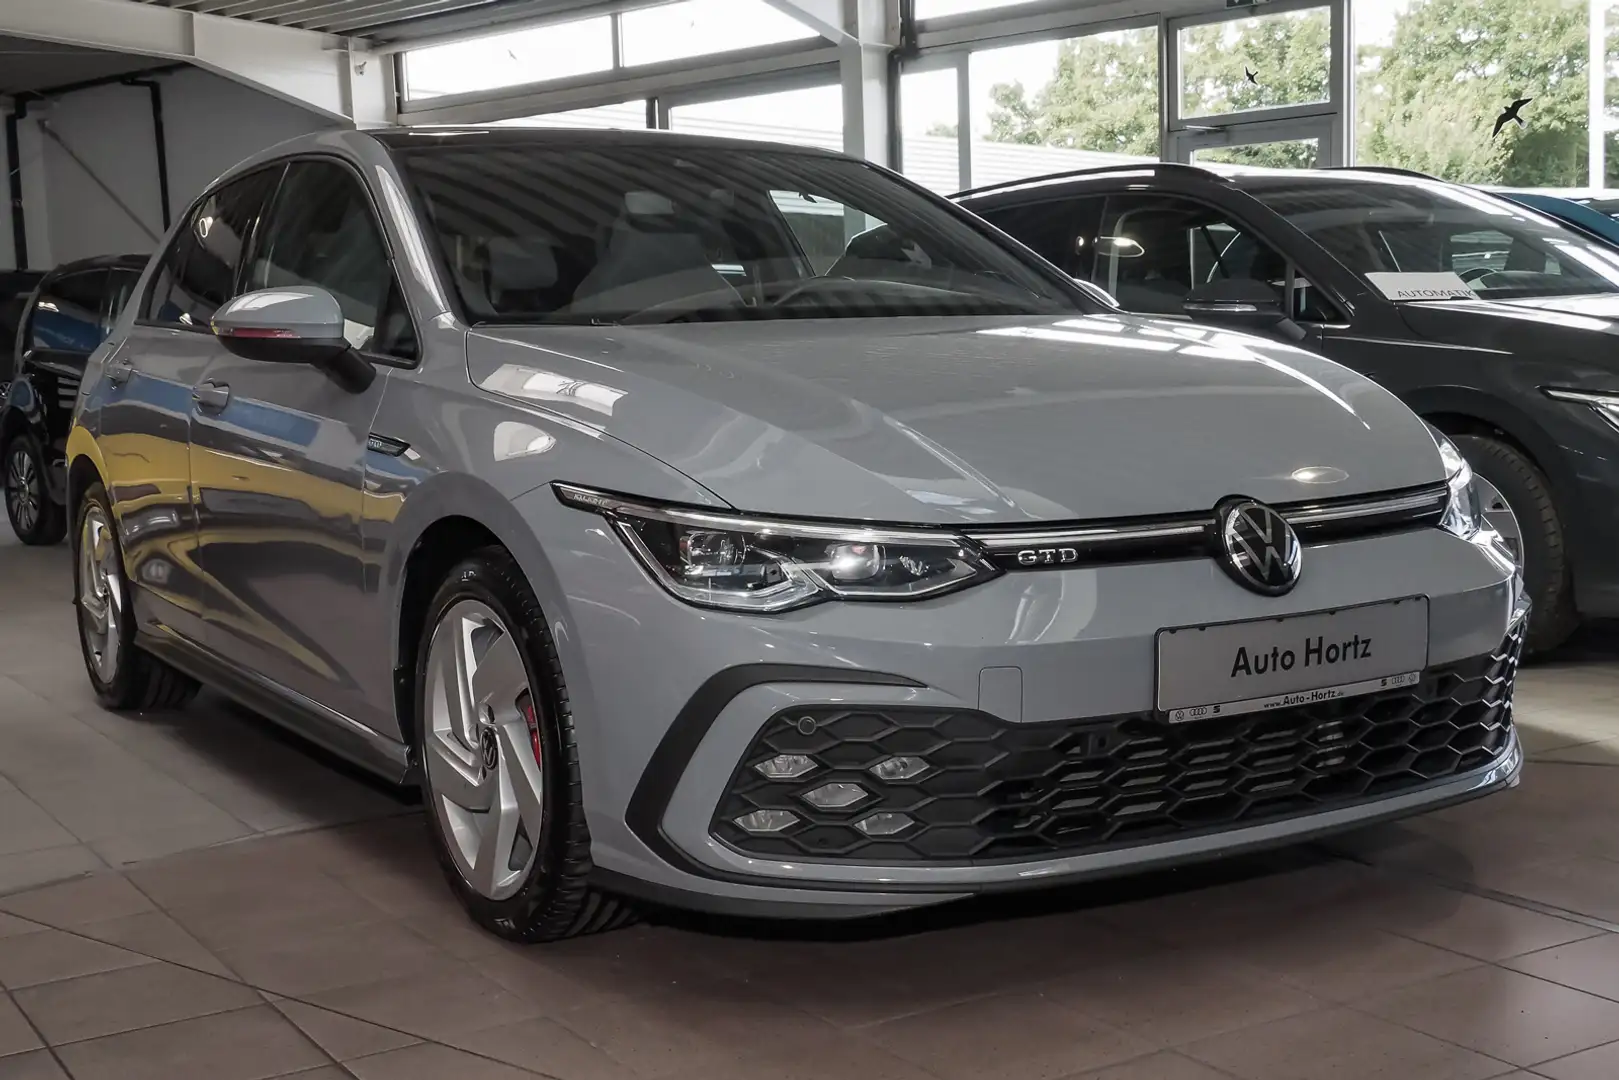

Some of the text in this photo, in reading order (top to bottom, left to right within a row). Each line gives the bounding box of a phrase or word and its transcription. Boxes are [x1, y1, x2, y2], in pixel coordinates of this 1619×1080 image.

[1397, 289, 1475, 298] AUTOMATIK
[1017, 548, 1078, 565] GTD
[1230, 634, 1372, 678] Auto Hortz
